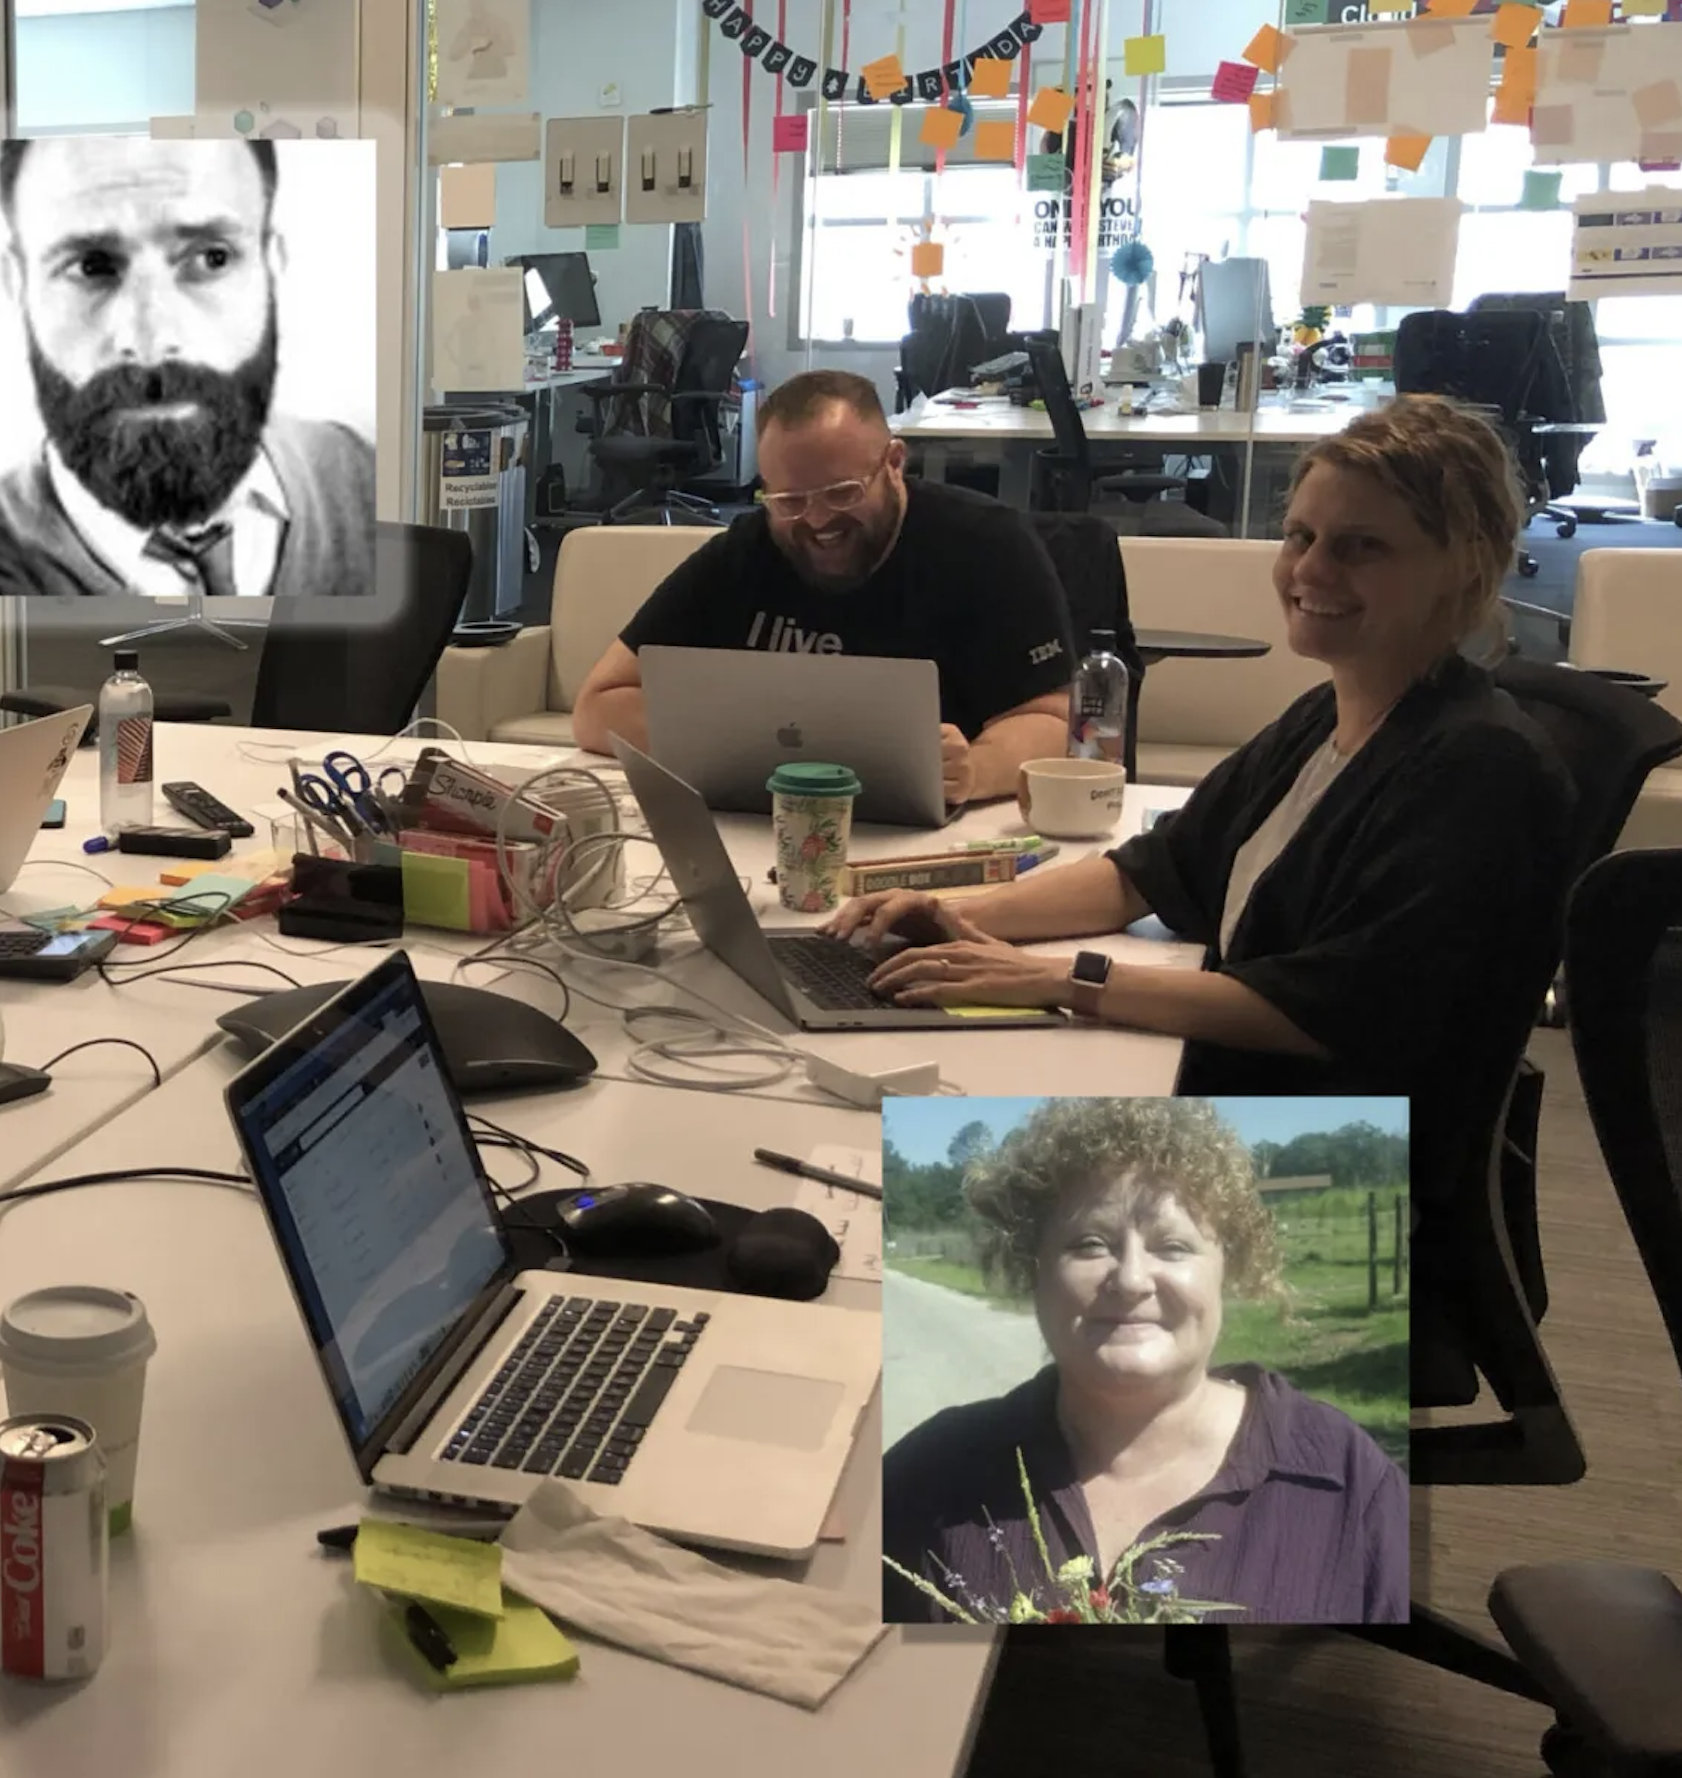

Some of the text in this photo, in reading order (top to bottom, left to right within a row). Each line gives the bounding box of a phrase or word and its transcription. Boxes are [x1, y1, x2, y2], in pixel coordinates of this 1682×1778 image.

[746, 611, 843, 656] I live
[1029, 638, 1063, 665] IBM
[427, 774, 497, 811] Sharpie
[4, 1490, 40, 1592] Coke
